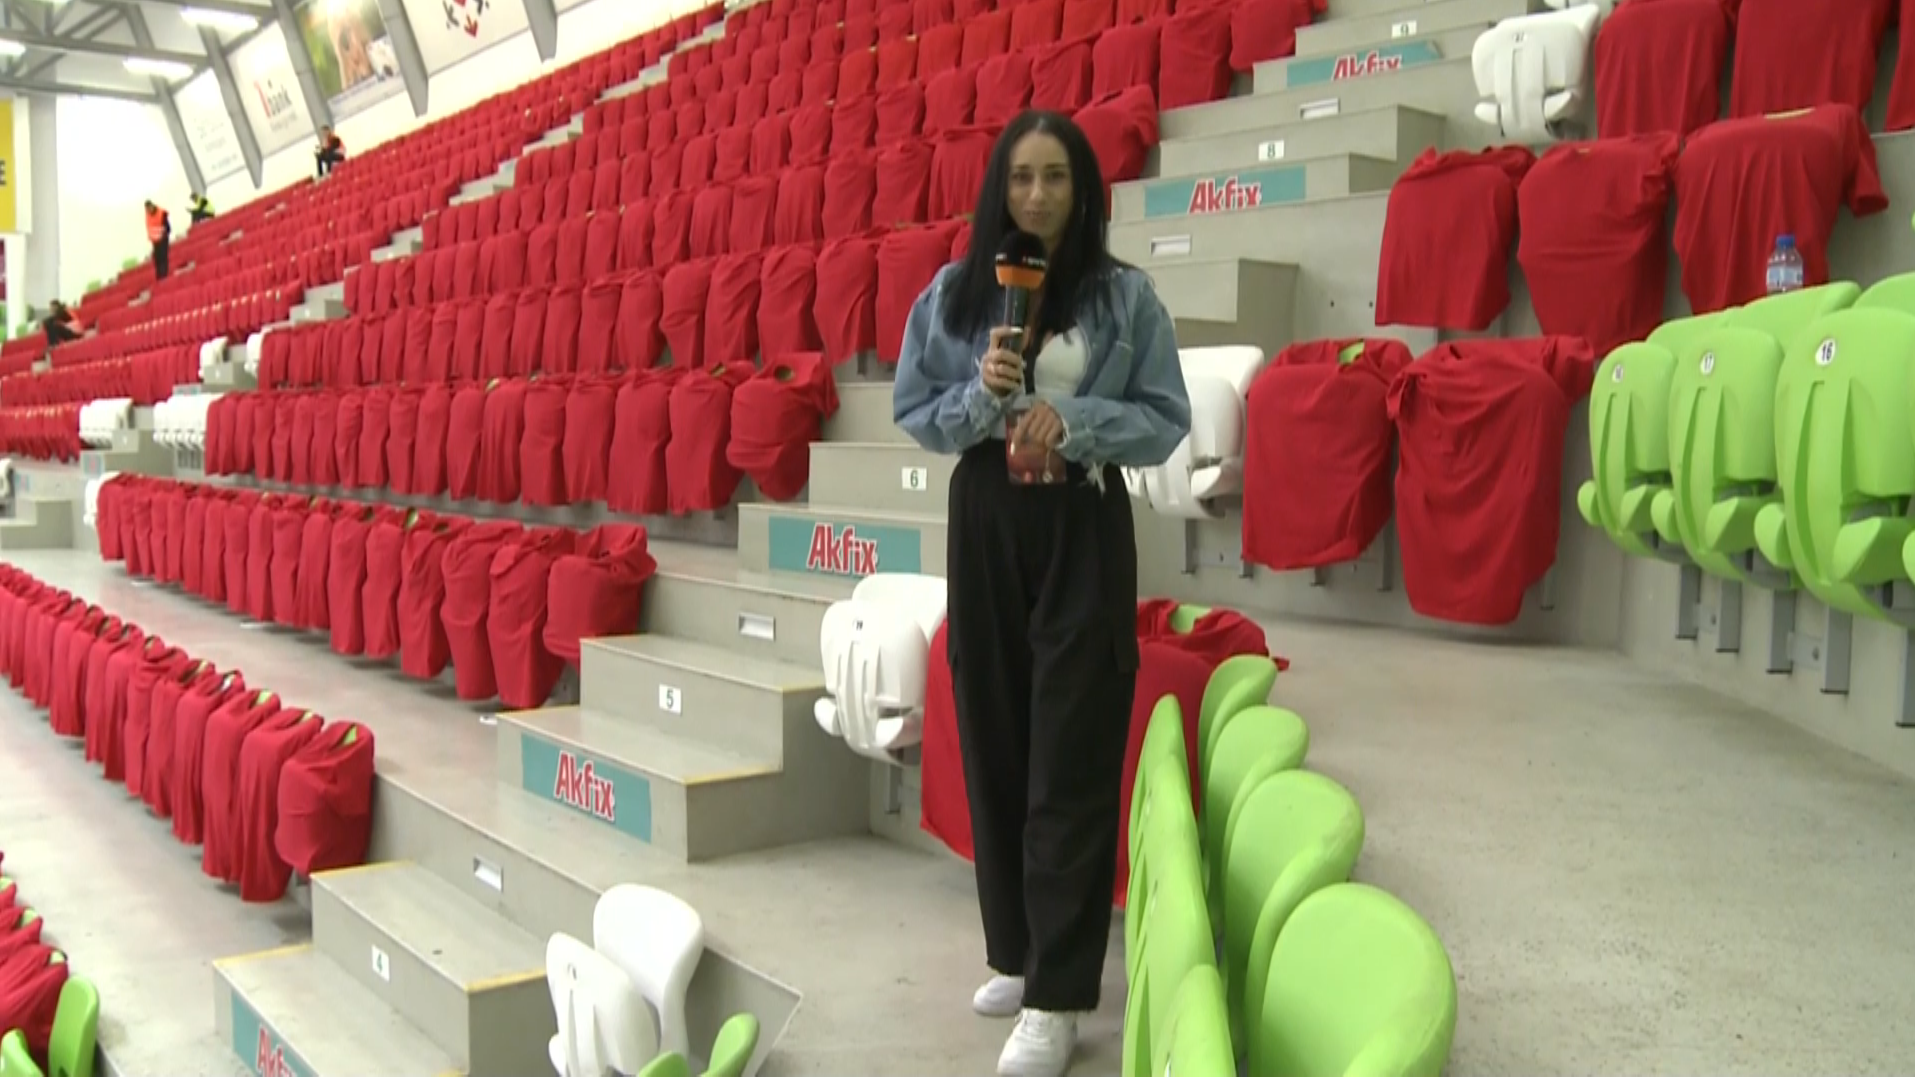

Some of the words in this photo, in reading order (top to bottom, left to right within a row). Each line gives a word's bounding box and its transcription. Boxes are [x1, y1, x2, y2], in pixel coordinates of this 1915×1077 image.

[1400, 23, 1409, 37] 9
[1267, 143, 1276, 158] 8
[1187, 175, 1261, 214] Akfix
[1821, 341, 1833, 361] 16
[1704, 353, 1714, 371] 17
[910, 469, 919, 488] 6
[807, 522, 878, 577] Akfix
[666, 687, 674, 709] 5
[554, 750, 615, 822] Akfix
[376, 952, 383, 972] 4
